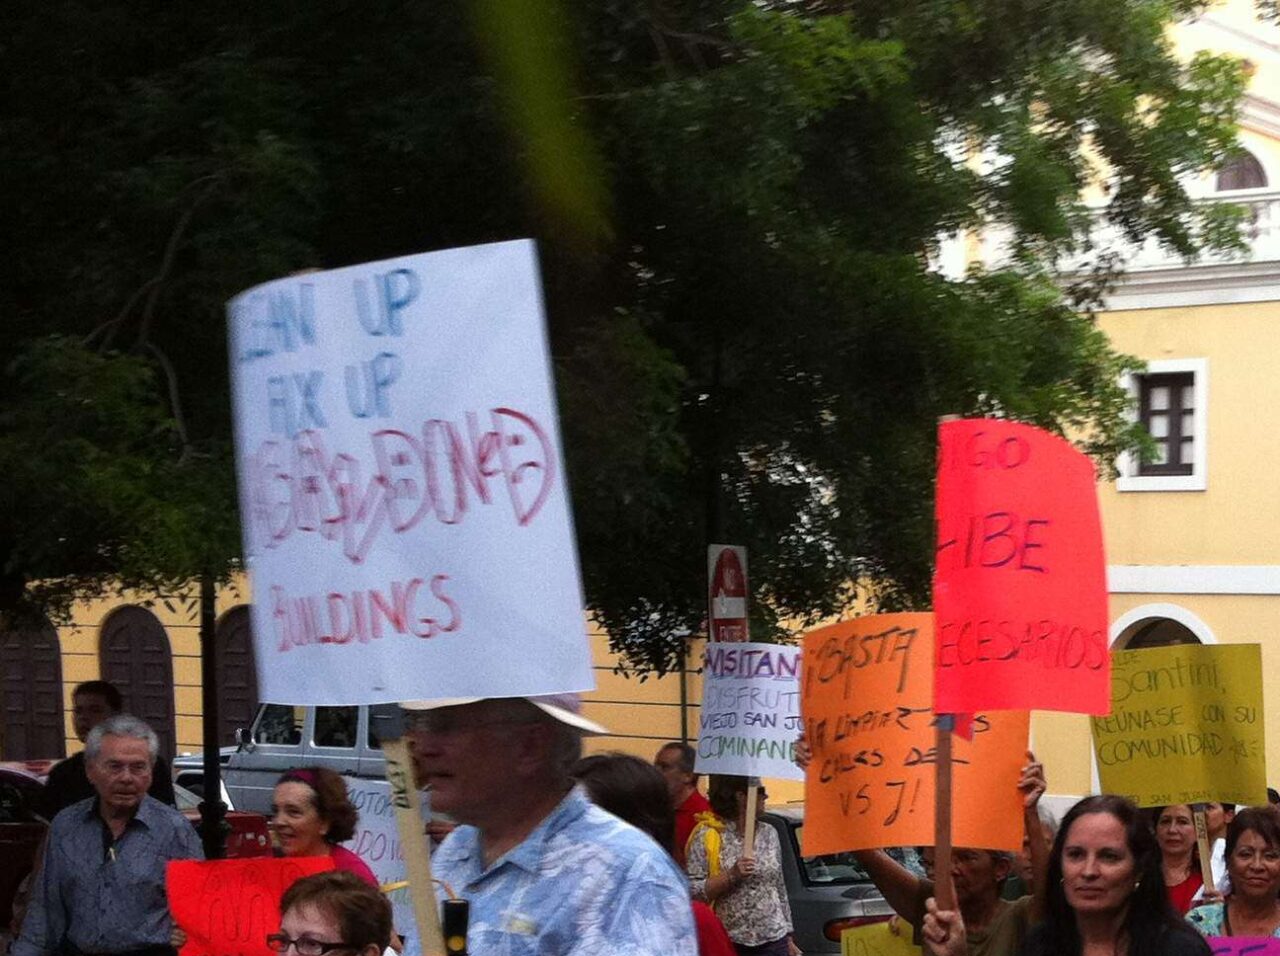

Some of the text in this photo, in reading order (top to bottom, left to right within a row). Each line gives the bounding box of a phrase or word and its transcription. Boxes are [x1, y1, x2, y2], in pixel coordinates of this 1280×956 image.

[353, 268, 421, 338] UP
[343, 351, 402, 420] UP
[269, 573, 463, 653] BUILDINGS
[743, 711, 777, 728] SAN
[1201, 703, 1227, 724] CON
[1233, 704, 1257, 725] SU
[1098, 732, 1224, 767] COMUNIDAD
